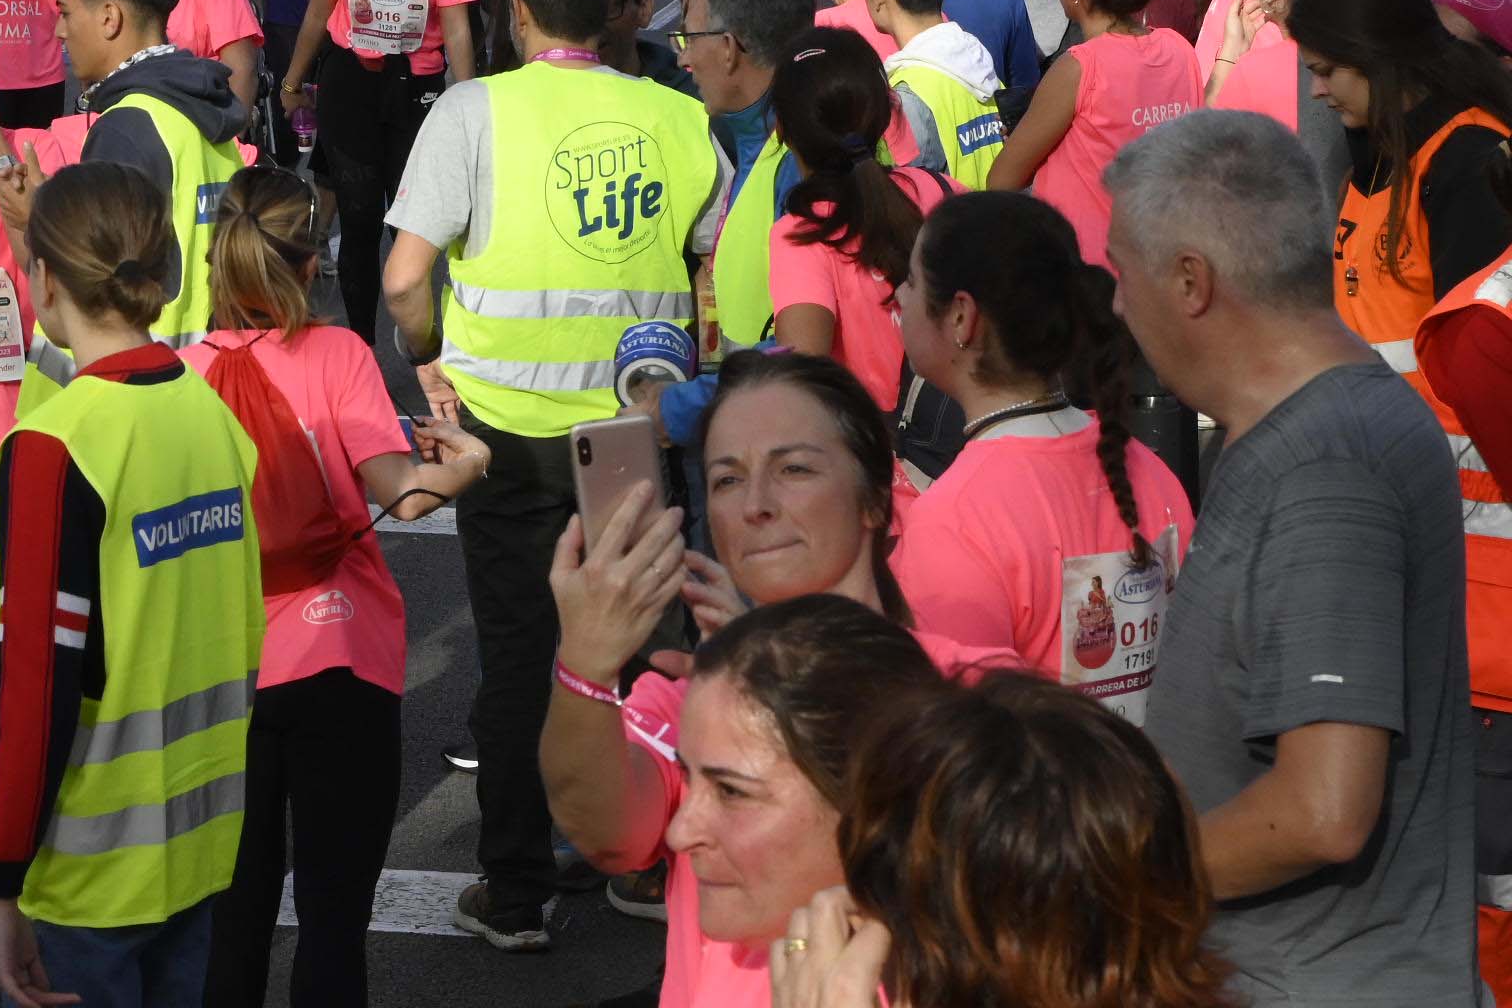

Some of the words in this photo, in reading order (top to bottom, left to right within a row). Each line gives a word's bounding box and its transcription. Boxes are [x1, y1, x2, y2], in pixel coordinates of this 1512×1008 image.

[375, 10, 401, 23] 016
[555, 135, 648, 190] Sport
[573, 172, 663, 241] Life
[620, 332, 686, 357] ASTURIANA
[137, 500, 242, 553] VOLUNTARIS
[1120, 611, 1159, 647] 016
[1126, 677, 1139, 688] DE
